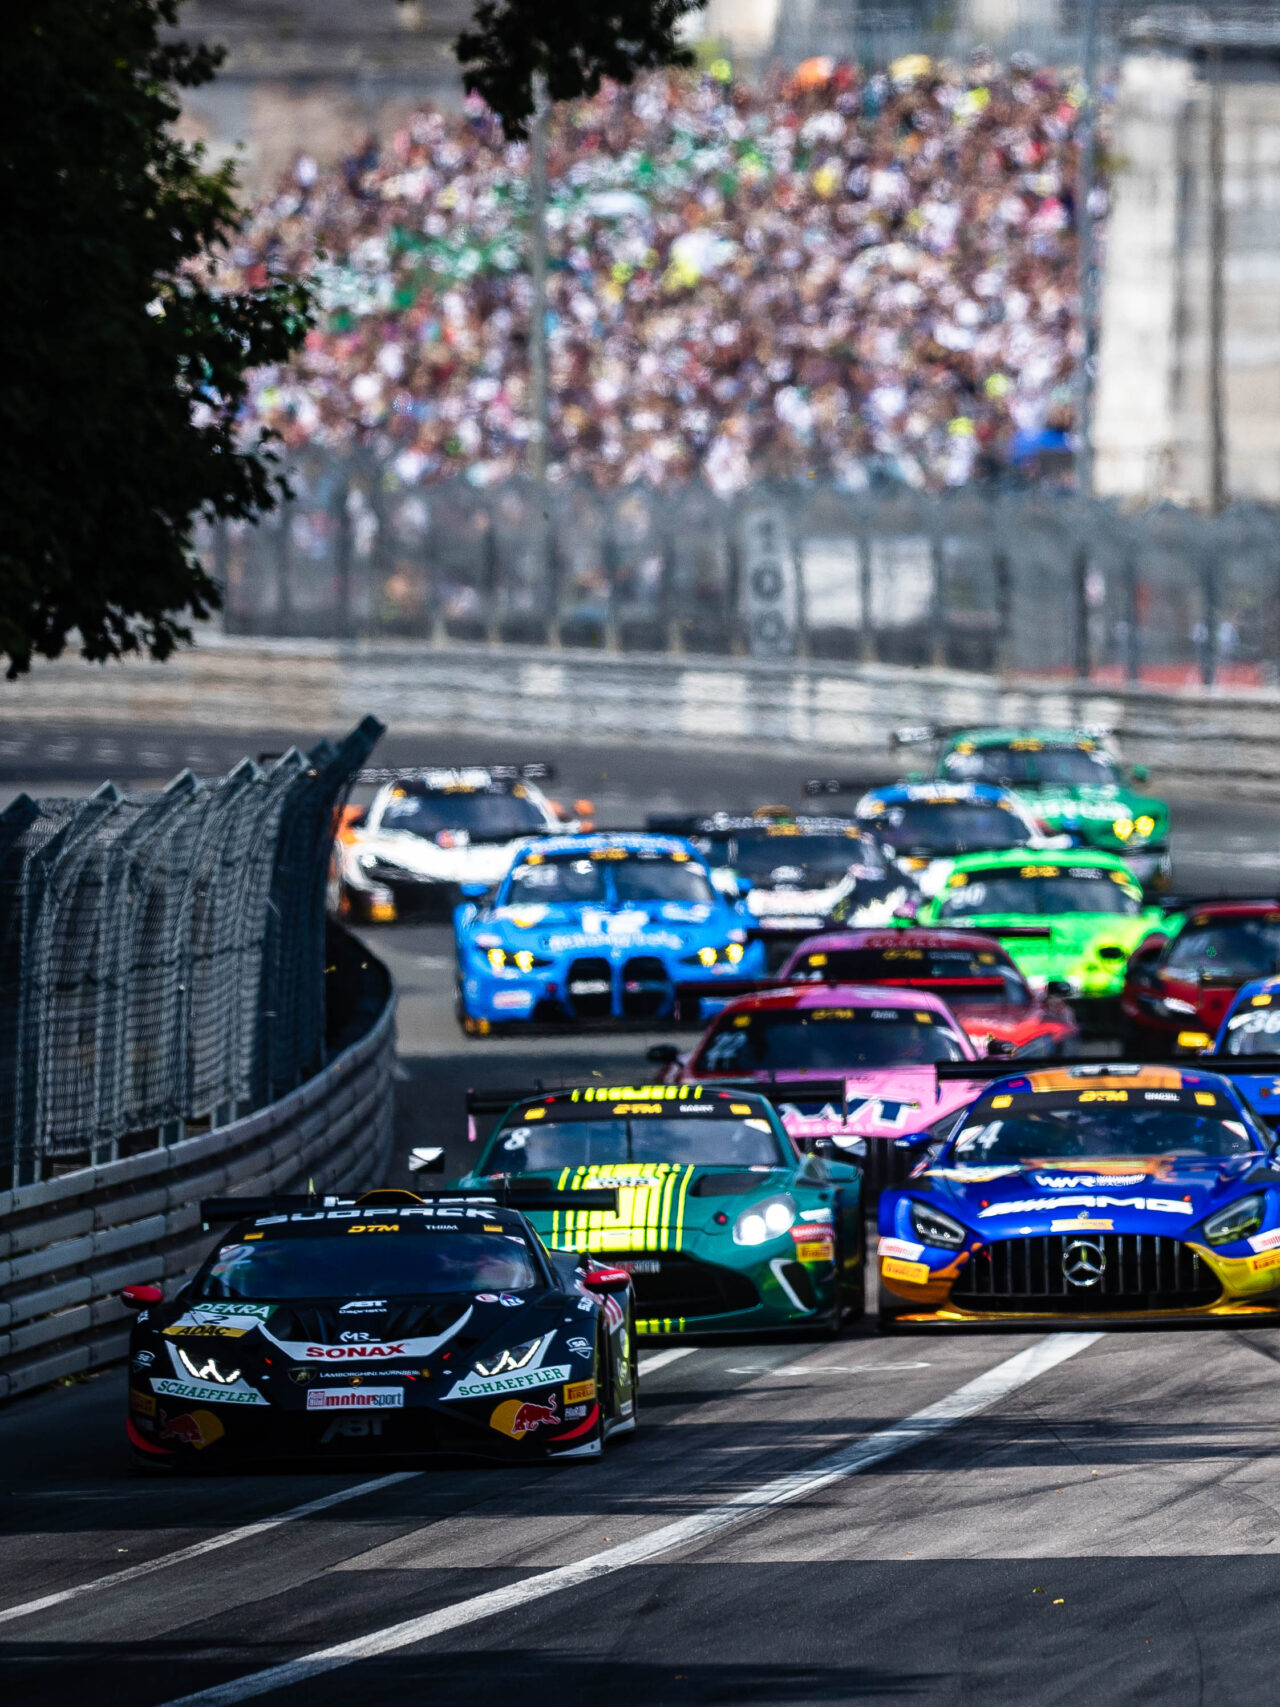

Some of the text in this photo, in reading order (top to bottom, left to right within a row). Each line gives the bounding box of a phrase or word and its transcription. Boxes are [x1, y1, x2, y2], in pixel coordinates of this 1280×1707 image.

[504, 1127, 532, 1150] 8
[348, 1223, 400, 1234] DTM
[193, 1303, 271, 1319] DEKRA
[340, 1299, 388, 1310] ABT
[203, 1315, 230, 1325] 2
[177, 1326, 232, 1337] ADAC
[305, 1343, 406, 1359] SONAX
[458, 1367, 566, 1397] SCHAEFFLER
[157, 1380, 259, 1404] SCHAEFFLER
[325, 1392, 402, 1407] motorsport
[319, 1413, 391, 1444] ABT
